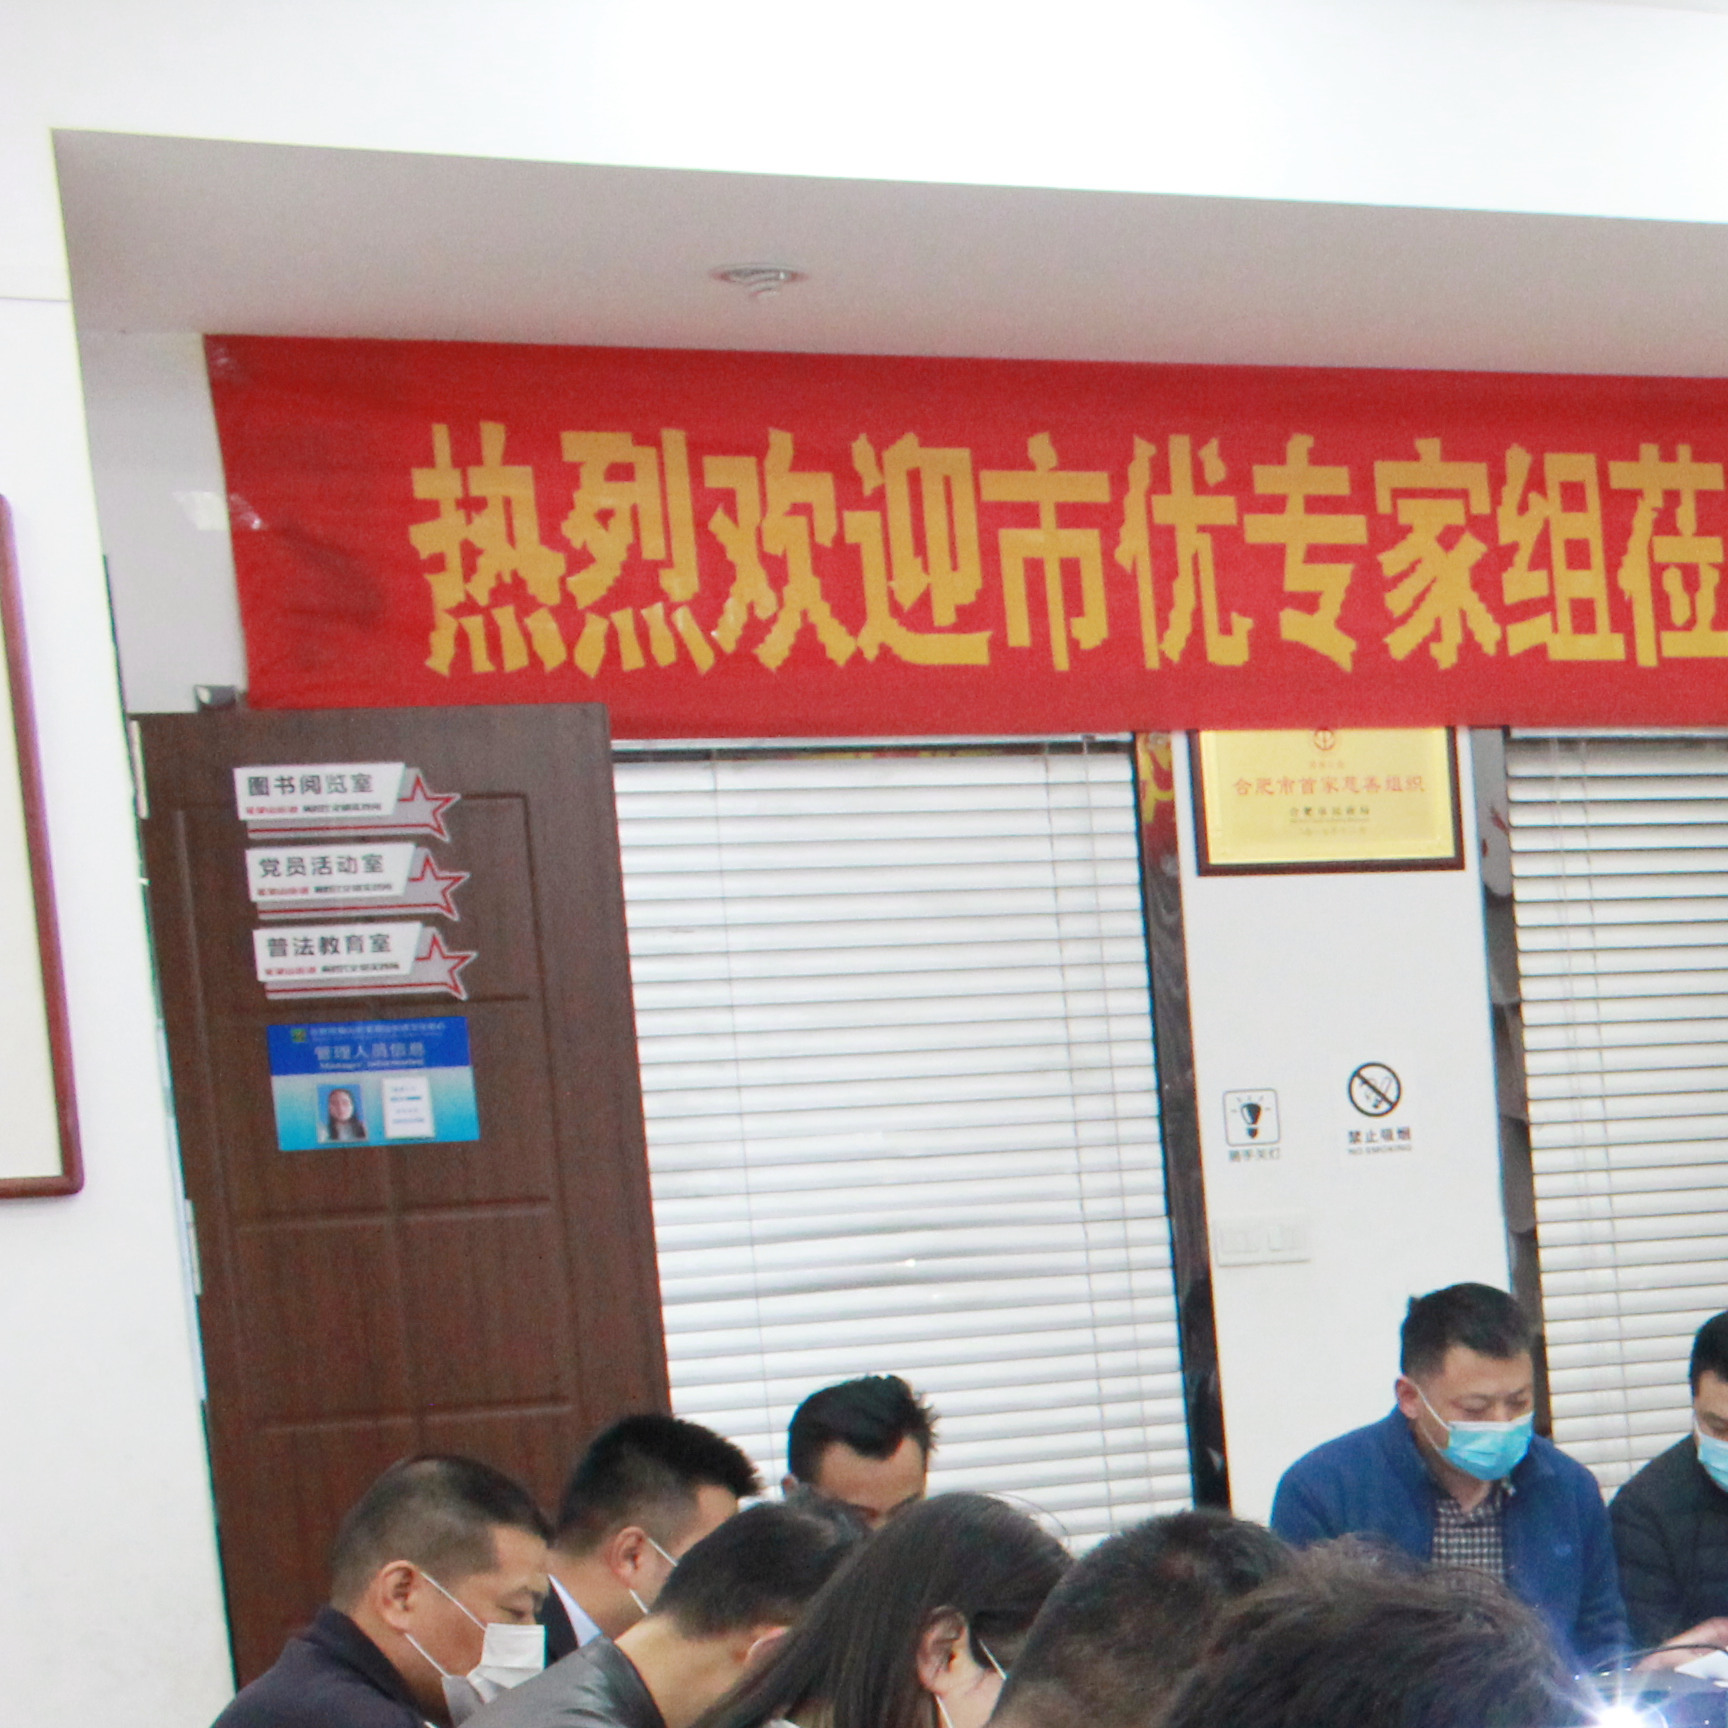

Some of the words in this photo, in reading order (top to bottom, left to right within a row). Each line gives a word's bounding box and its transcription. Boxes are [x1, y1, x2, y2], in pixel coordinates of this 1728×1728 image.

[247, 773, 374, 797] 图书阅览室
[1233, 775, 1426, 796] 合肥市首家慈善组织
[258, 854, 384, 879] 党员活动室
[267, 934, 391, 957] 普法教育室
[1348, 1127, 1412, 1144] 禁止吸烟
